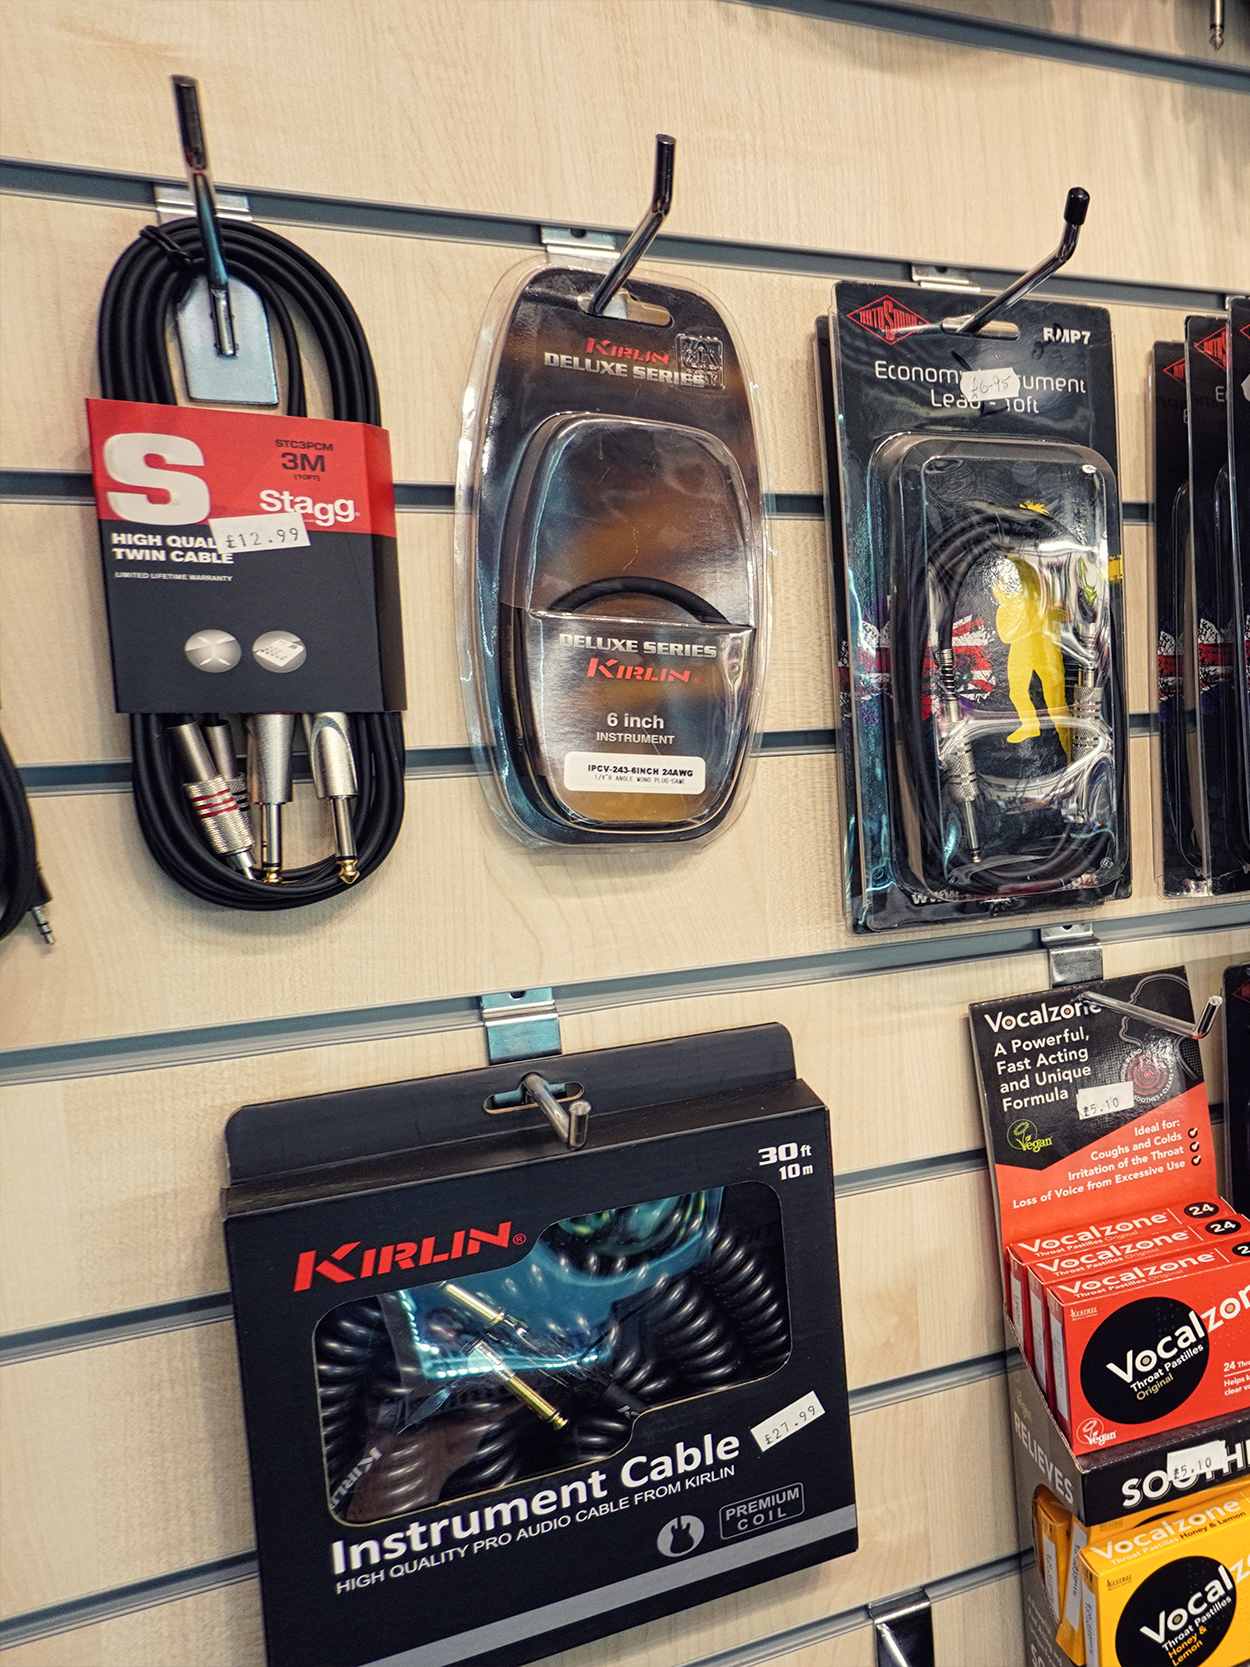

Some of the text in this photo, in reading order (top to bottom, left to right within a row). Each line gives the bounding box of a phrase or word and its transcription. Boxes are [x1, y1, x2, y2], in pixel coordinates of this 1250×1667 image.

[1043, 328, 1091, 344] RMP7
[586, 338, 669, 364] KIRLIN
[544, 352, 707, 388] DELUXE SERIES
[275, 439, 333, 451] STC3PCM
[281, 452, 325, 473] 3M
[103, 432, 211, 526] S
[260, 489, 356, 526] Stagg
[111, 533, 162, 547] HIGH
[226, 527, 299, 549] £12.99
[113, 549, 234, 564] TWIN CABLE
[115, 571, 149, 579] LIMITED
[189, 574, 233, 582] WARRANTY
[559, 633, 717, 658] DELUXE SERIES
[587, 658, 691, 683] KIRLIN
[607, 713, 664, 729] 6 inch
[596, 732, 675, 745] INSTRUMENT
[588, 764, 694, 777] IPCV-243-6INCH 24AWG
[994, 1027, 1090, 1057] A Powerful,
[996, 1049, 1089, 1076] Fast Acting
[1000, 1066, 1091, 1094] and Unique
[1002, 1087, 1069, 1112] Formula
[1083, 1098, 1119, 1117] £5.10
[1134, 1119, 1180, 1137] Ideal for:
[1091, 1132, 1182, 1162] Coughs and Colds
[1068, 1146, 1184, 1182] Irritation of the Throat
[1013, 1160, 1185, 1210] Loss of Voice from Excessive Use
[1018, 1203, 1214, 1253] Vocalzone 24
[293, 1222, 512, 1292] KIRLIN
[1036, 1221, 1236, 1273] Vocalzone 24
[1058, 1252, 1215, 1294] Vocalzone
[1130, 1344, 1204, 1393] Throat Pastilles
[1224, 1362, 1236, 1372] 24
[1136, 1373, 1173, 1401] Original
[1224, 1378, 1244, 1388] Helps
[1224, 1385, 1243, 1396] clear
[765, 1405, 816, 1445] £27.99
[1173, 1457, 1212, 1479] £5.10
[332, 1433, 741, 1575] Instrument Cable
[725, 1487, 799, 1521] PREMIUM
[336, 1465, 736, 1595] HIGH QUALITY PRO AUDIO CABLE FROM KIRLIN
[737, 1507, 787, 1531] COIL
[1090, 1498, 1242, 1560] Vocalzone
[1110, 1511, 1246, 1566] Throat Pastilles Honey & Lemon
[1162, 1595, 1232, 1652] Throat Pastilles
[1168, 1626, 1207, 1659] Honey &
[1171, 1639, 1203, 1666] Lemon
